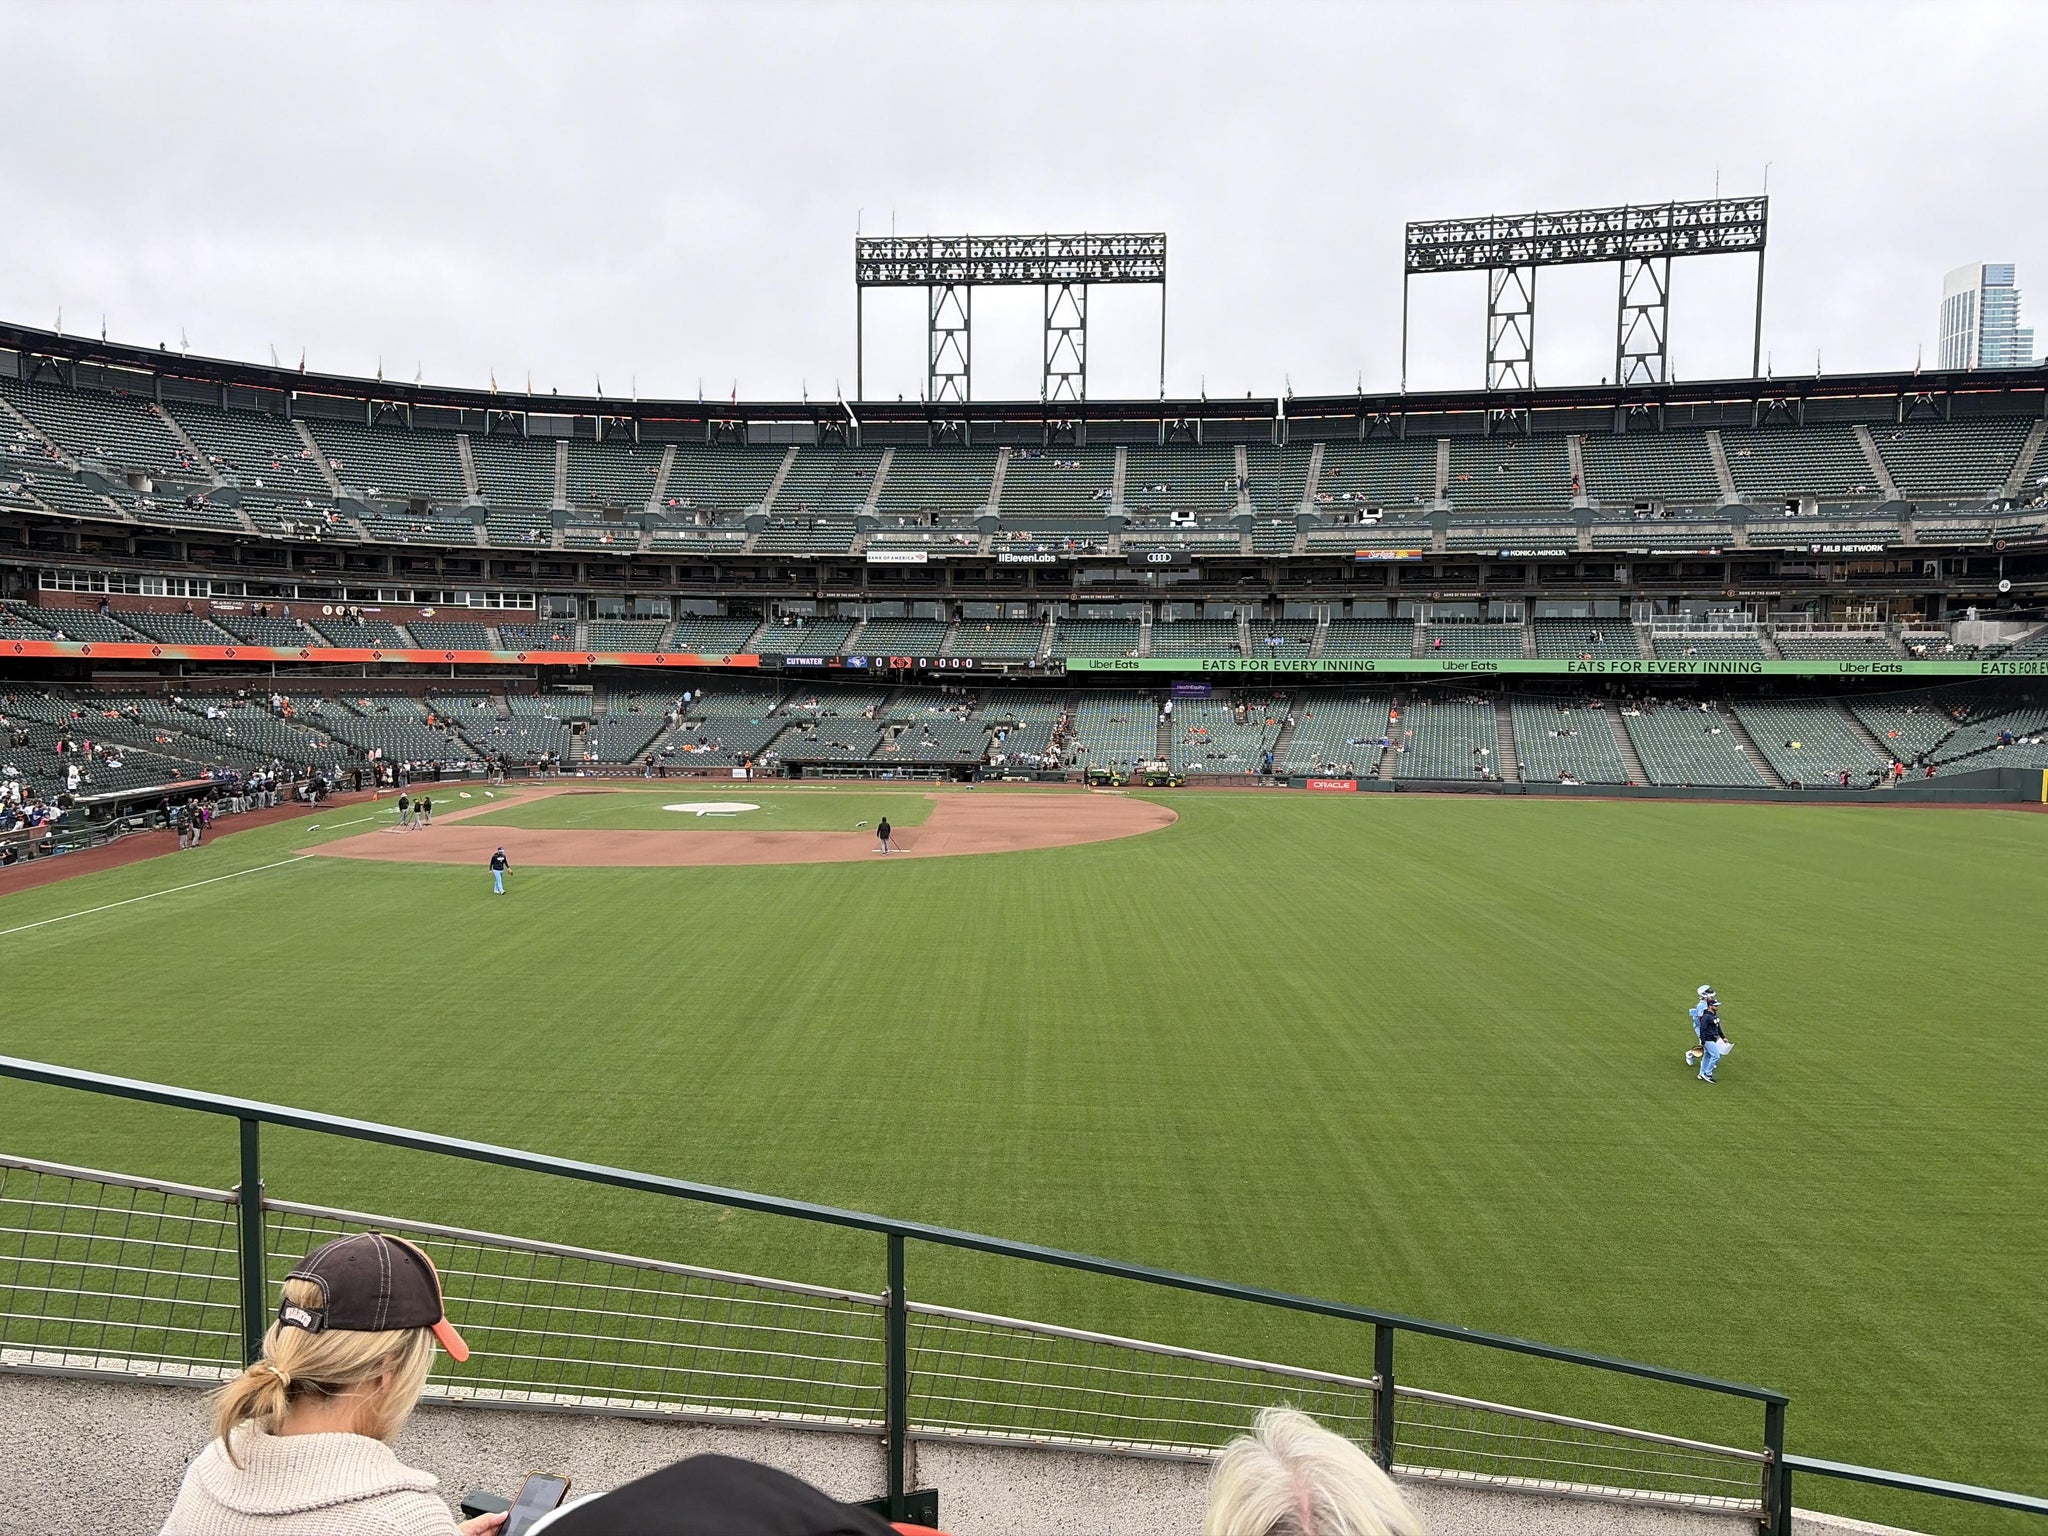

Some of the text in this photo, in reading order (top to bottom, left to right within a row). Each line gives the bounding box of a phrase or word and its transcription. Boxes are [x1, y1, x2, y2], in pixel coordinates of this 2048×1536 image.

[1842, 544, 1883, 552] NETWORK
[786, 657, 823, 665] CUTWATER
[876, 658, 882, 667] 0
[920, 658, 926, 667] 0
[940, 658, 946, 667] 0
[953, 659, 959, 667] 0
[966, 659, 973, 667] 0
[1089, 660, 1139, 669] Uber Eats
[1202, 660, 1375, 671] EATS FOR EVERY INNING
[1442, 661, 1498, 670] Uber Eats
[1568, 662, 1762, 673] EATS FOR EVERY INNING
[1839, 663, 1903, 673] Uber Eats
[1981, 663, 2016, 674] EATS
[2019, 662, 2037, 674] FOR
